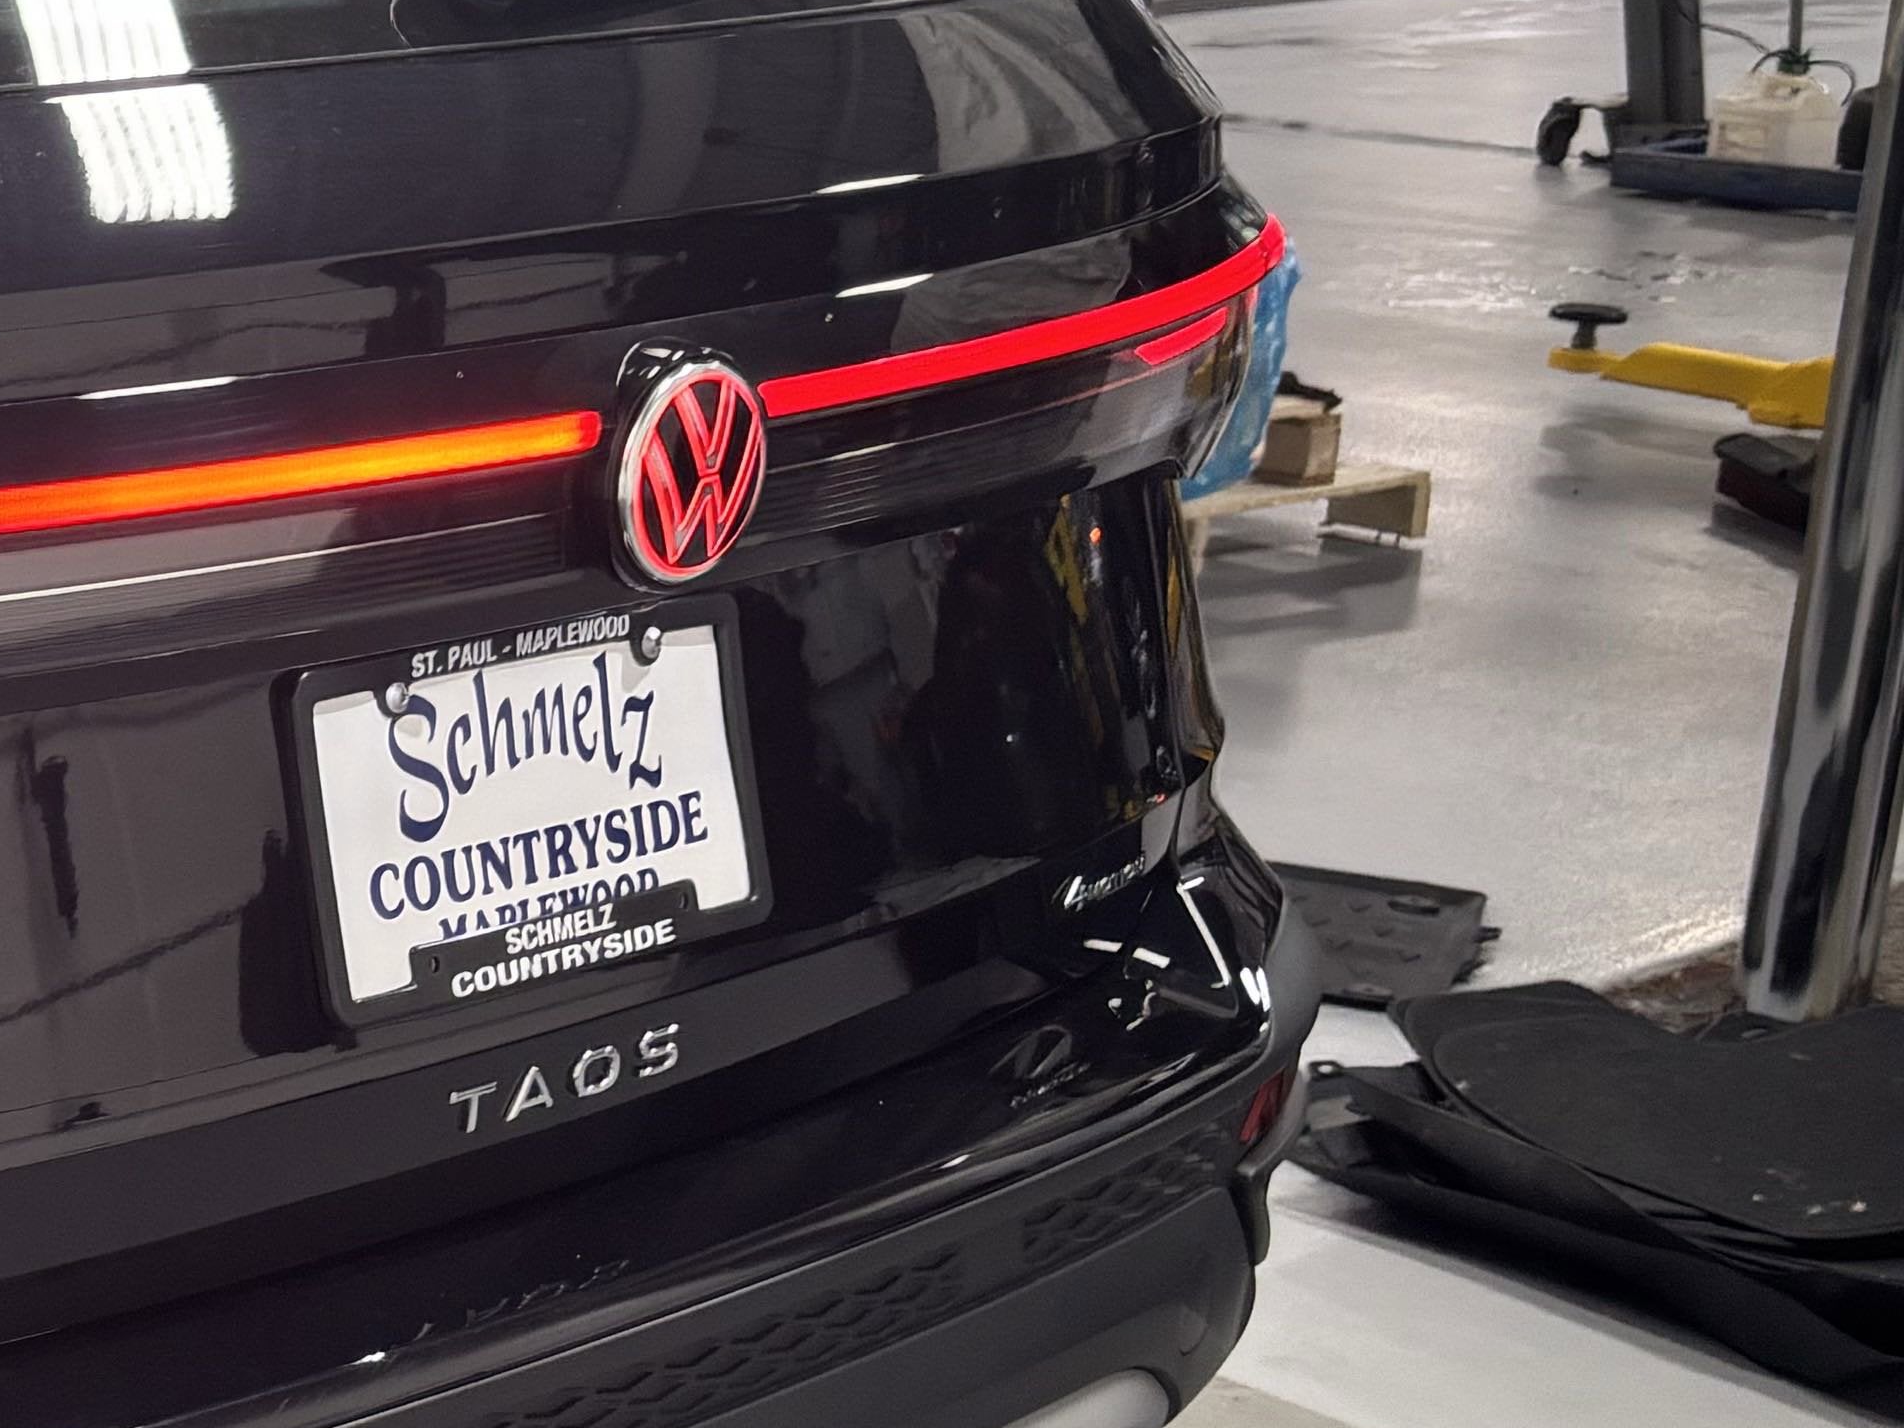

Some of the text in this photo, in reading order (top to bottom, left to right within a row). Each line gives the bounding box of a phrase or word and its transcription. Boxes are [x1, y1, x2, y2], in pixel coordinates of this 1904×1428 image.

[411, 649, 442, 678] ST.
[448, 639, 497, 670] PAUL
[516, 614, 630, 656] MAPLEWOOD
[387, 651, 663, 843] Schmelz
[369, 790, 709, 923] COUNTRYSIDE
[451, 918, 678, 998] COUNTRYSIDE
[505, 903, 617, 955] SCHMELZ
[449, 1023, 680, 1133] TAOS
